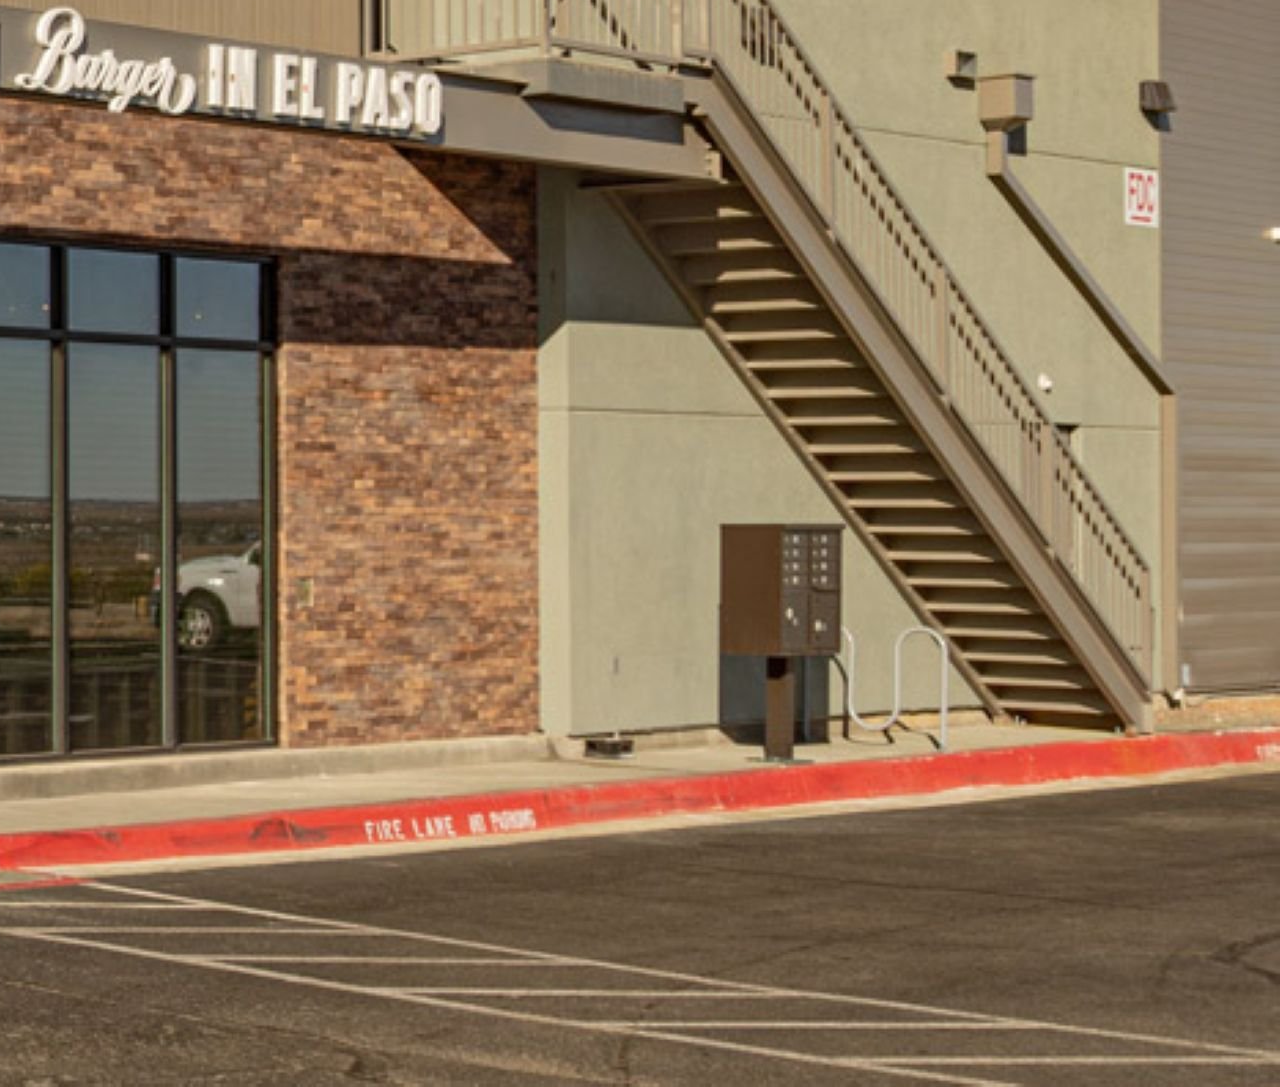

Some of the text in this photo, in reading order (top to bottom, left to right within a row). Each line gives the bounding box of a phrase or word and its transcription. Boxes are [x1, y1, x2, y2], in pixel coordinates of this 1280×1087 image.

[14, 6, 197, 114] Burger
[207, 43, 259, 112] IN
[272, 53, 326, 121] EL
[336, 61, 444, 136] PASO
[1128, 173, 1157, 212] FDC
[363, 818, 406, 844] FIRE
[410, 814, 457, 839] LANE
